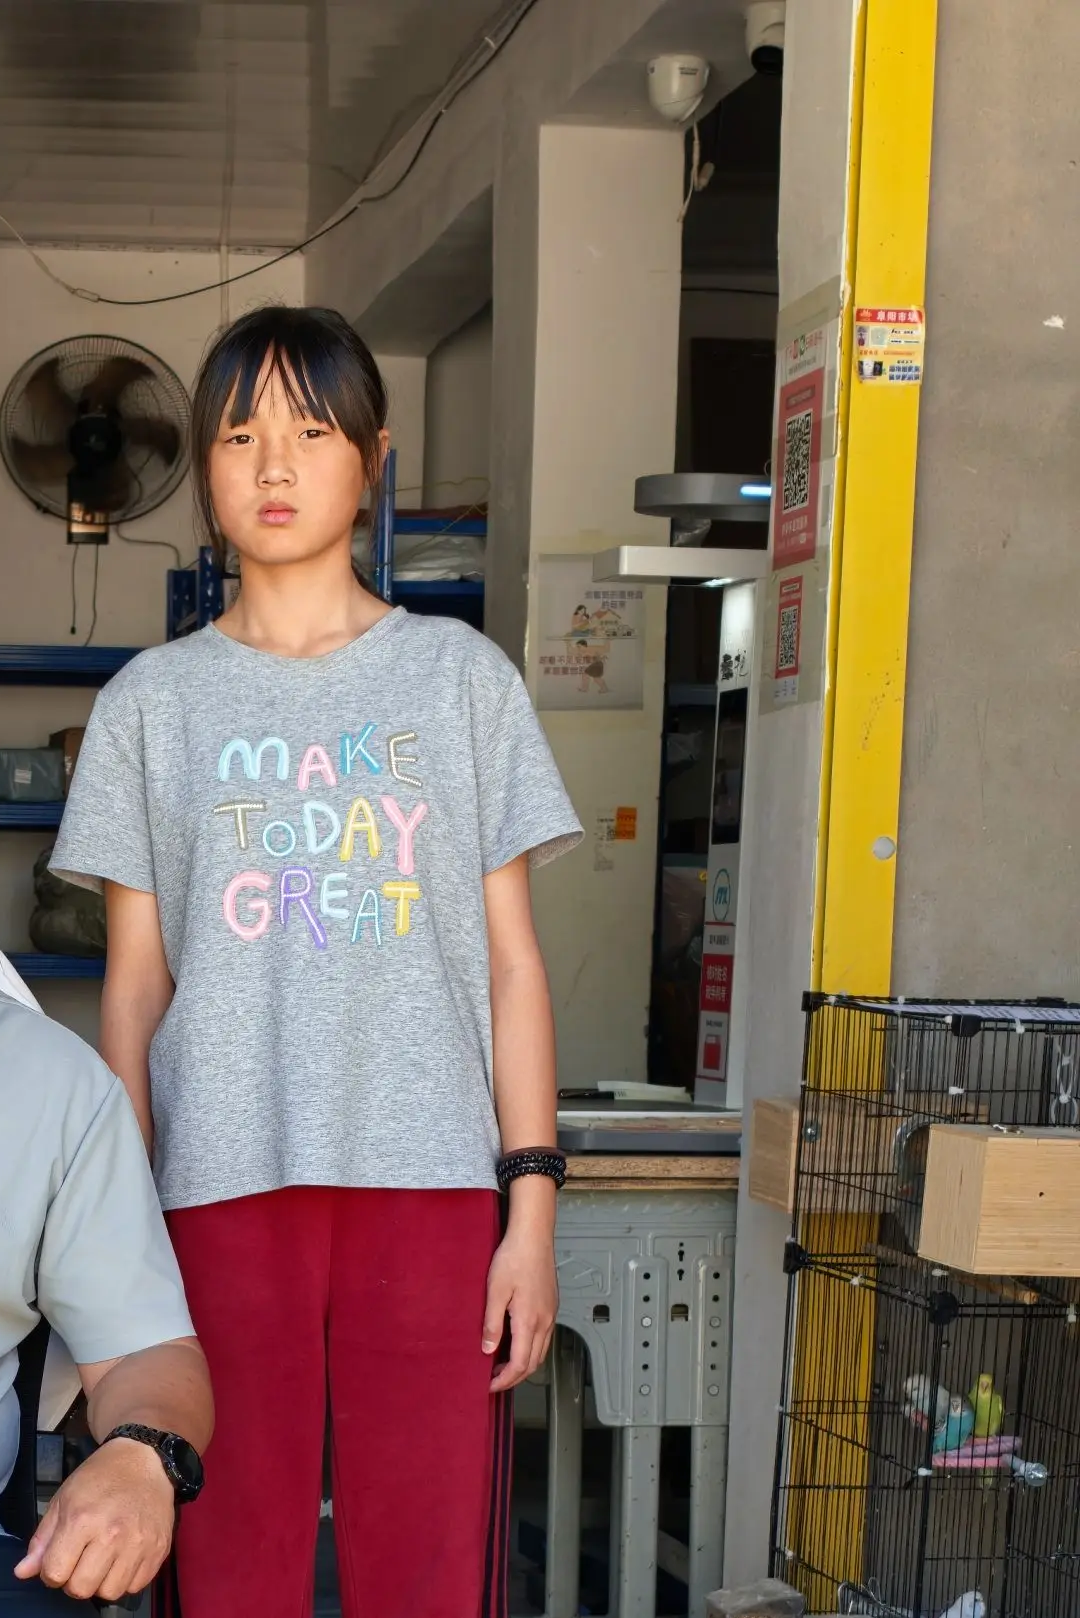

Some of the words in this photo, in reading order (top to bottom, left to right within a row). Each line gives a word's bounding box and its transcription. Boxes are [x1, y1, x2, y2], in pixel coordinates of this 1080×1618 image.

[218, 721, 422, 792] MAKE
[213, 794, 429, 875] TODAY
[222, 865, 422, 950] GREAT
